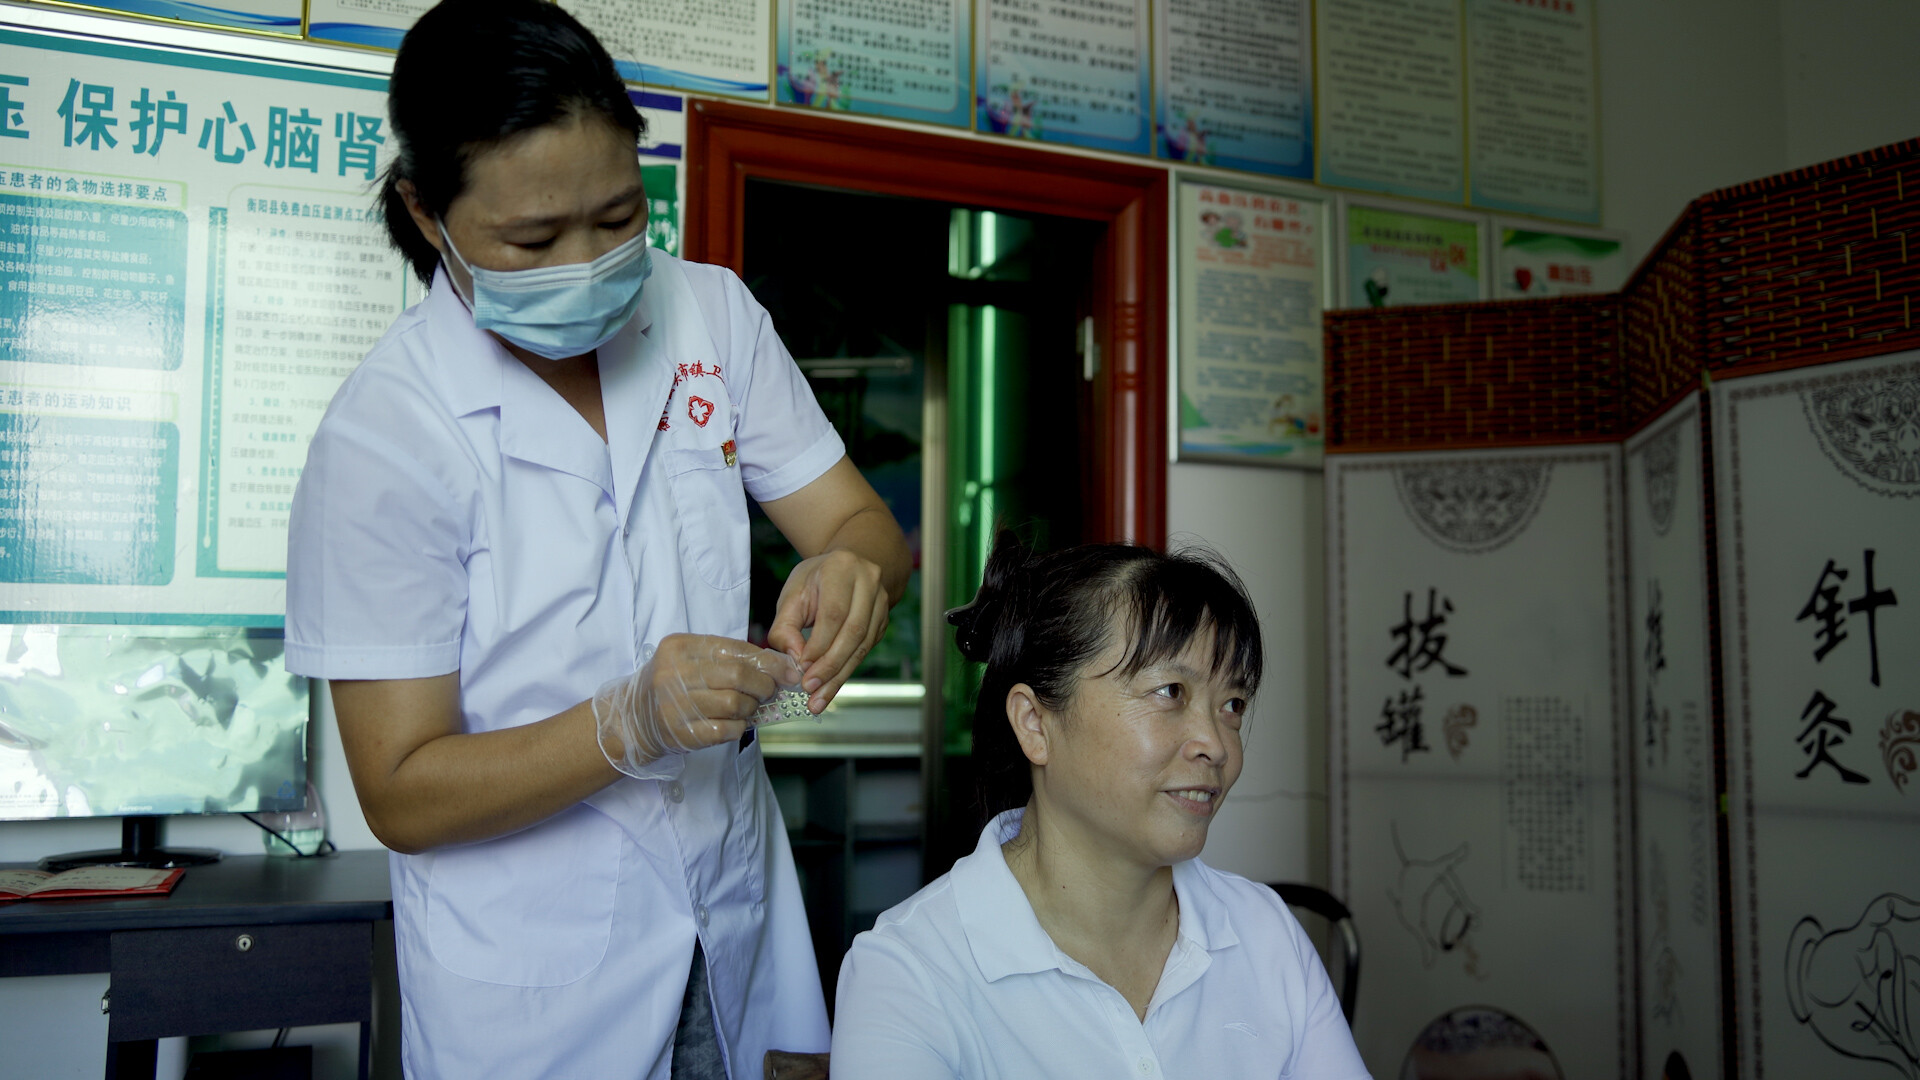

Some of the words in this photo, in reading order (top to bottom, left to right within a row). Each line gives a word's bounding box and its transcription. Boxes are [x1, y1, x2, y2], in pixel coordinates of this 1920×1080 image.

[57, 78, 386, 181] 保护心脑肾
[0, 390, 131, 412] 患者的运动知识
[1374, 587, 1469, 764] 拔罐
[1795, 548, 1898, 784] 針灸
